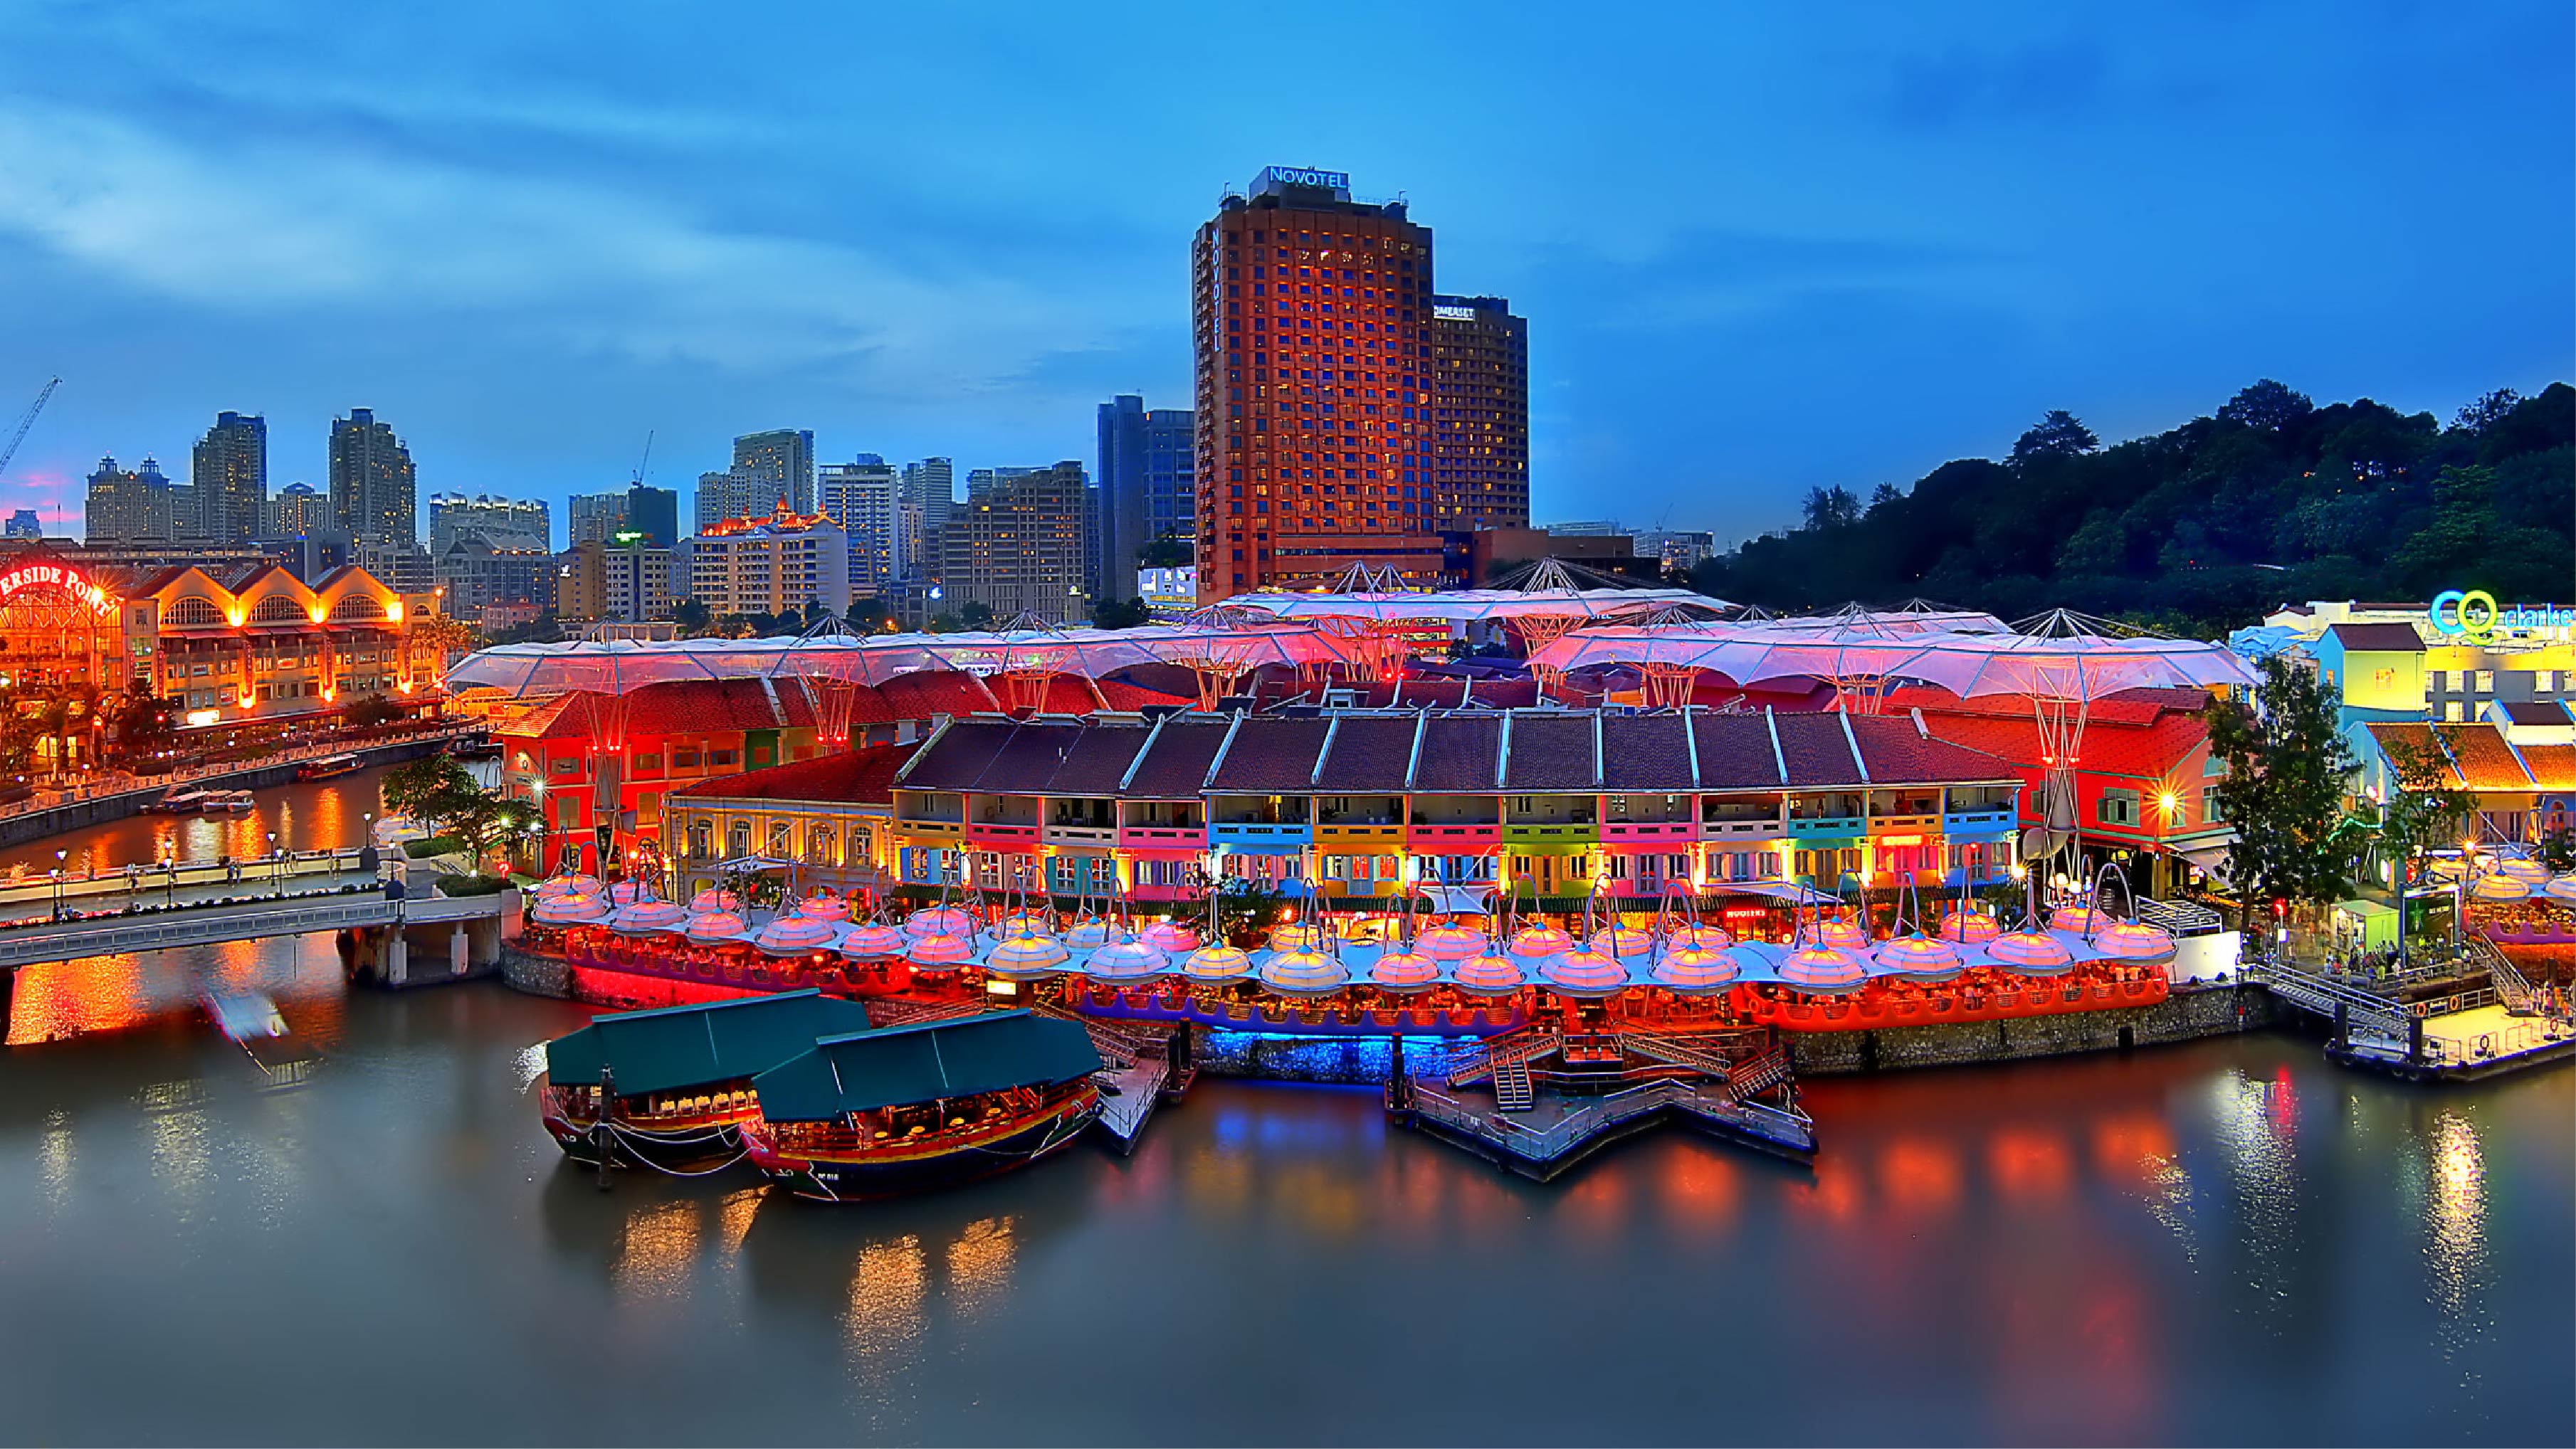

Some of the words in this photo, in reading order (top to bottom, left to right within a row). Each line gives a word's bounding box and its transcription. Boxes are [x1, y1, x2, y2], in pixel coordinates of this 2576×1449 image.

[1270, 167, 1347, 188] NOVOTEL
[0, 566, 62, 596] ERSIDE
[64, 569, 112, 617] POIT
[2504, 602, 2573, 628] clarke
